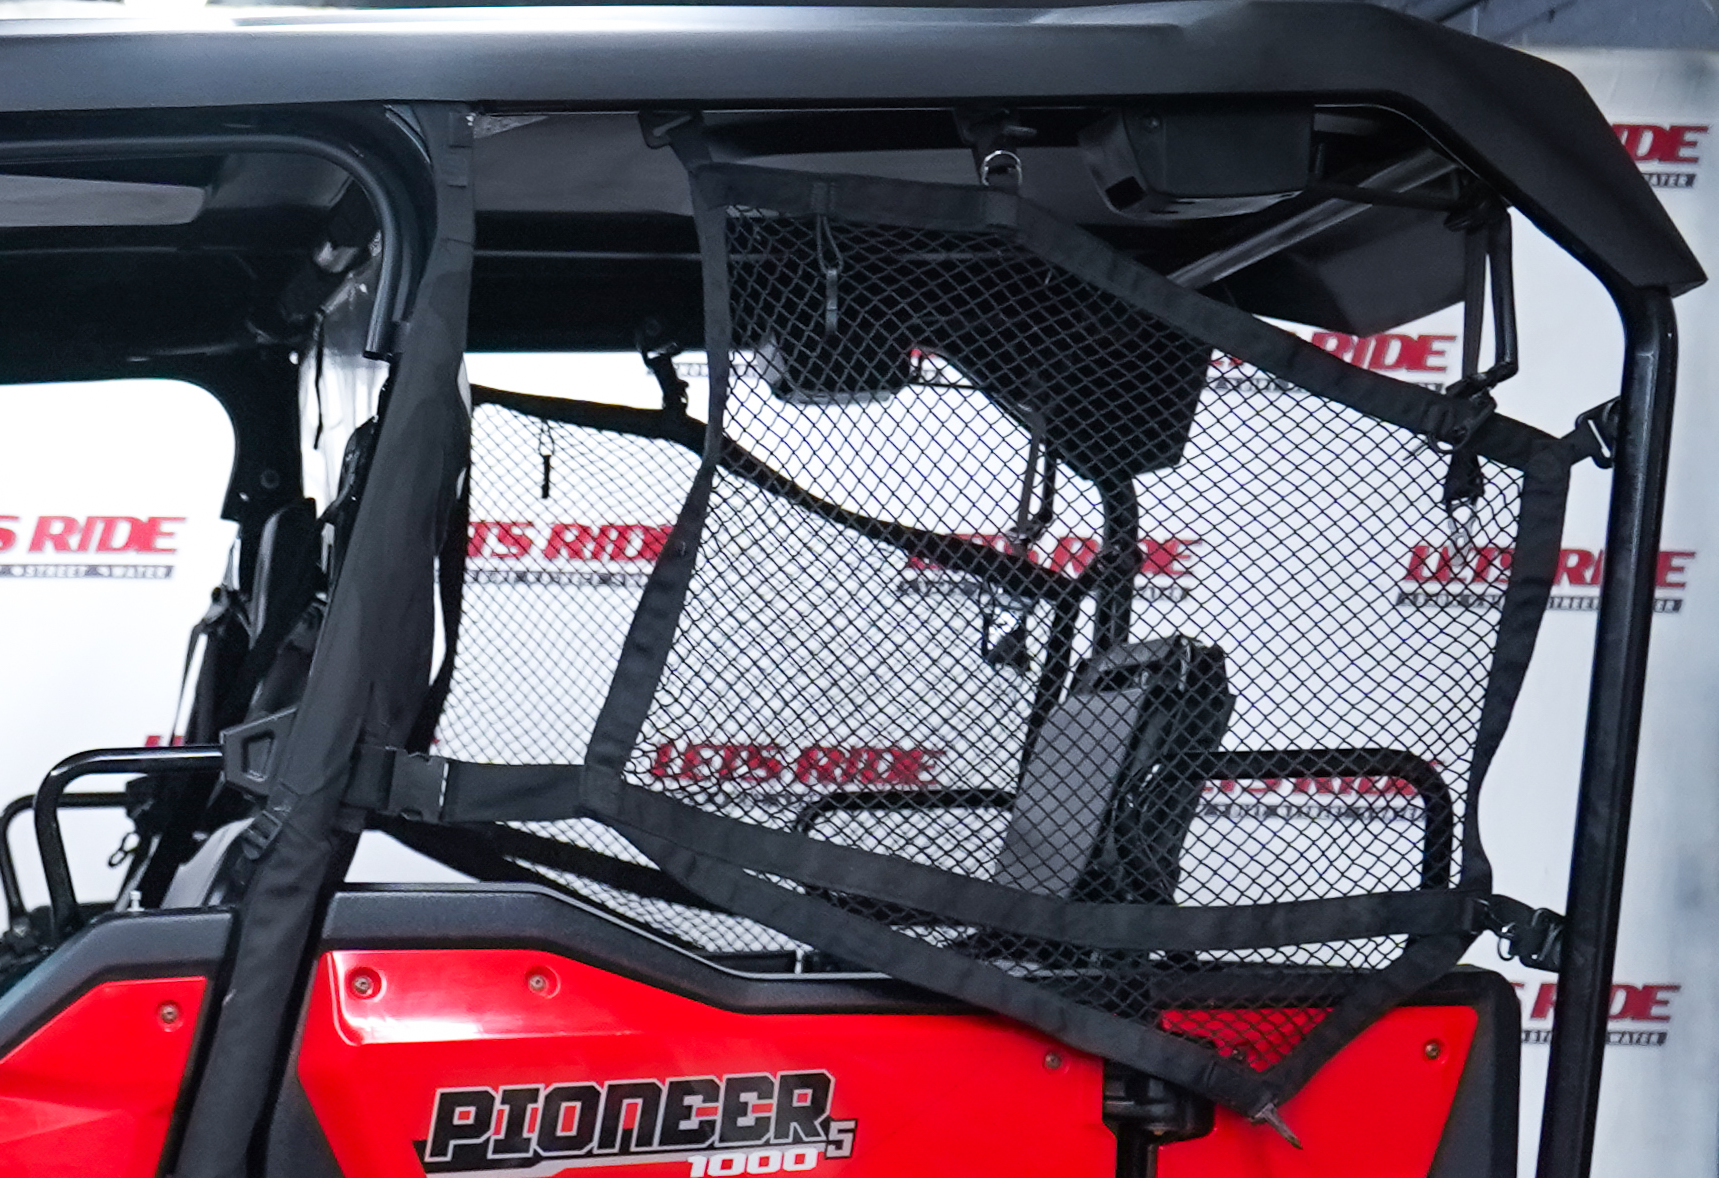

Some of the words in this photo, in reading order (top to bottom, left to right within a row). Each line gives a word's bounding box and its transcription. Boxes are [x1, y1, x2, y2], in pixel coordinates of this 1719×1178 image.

[1610, 123, 1709, 163] DE
[27, 515, 187, 553] RIDE
[467, 520, 535, 559] TS
[1553, 548, 1696, 587] RIE
[425, 1068, 835, 1163] PIONEER
[686, 1146, 820, 1178] 1000
